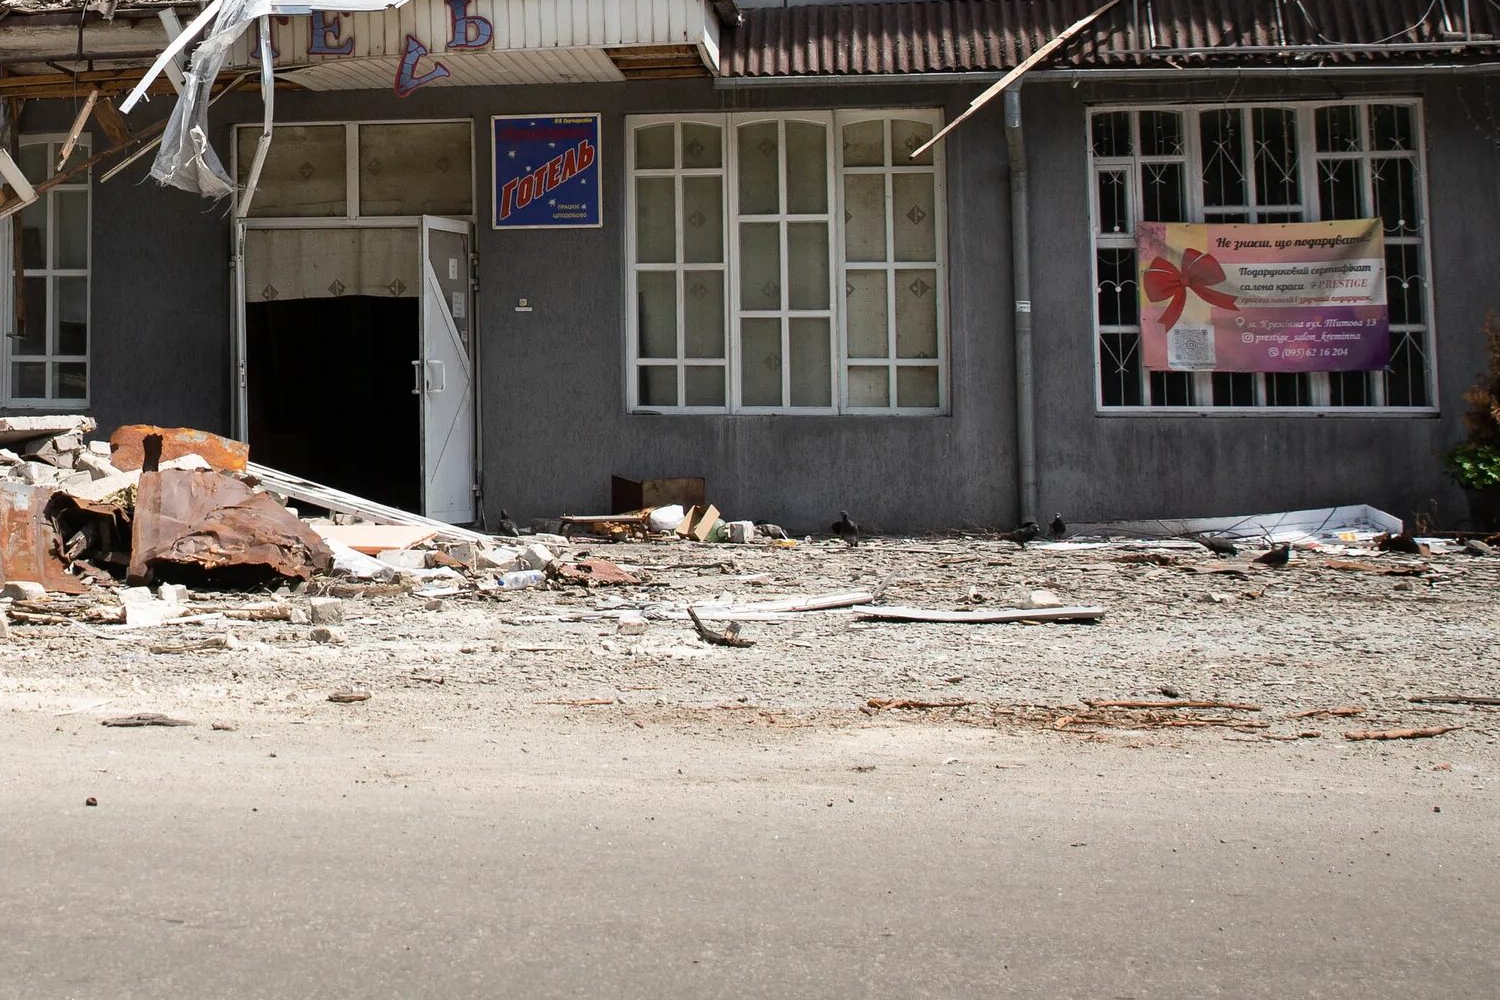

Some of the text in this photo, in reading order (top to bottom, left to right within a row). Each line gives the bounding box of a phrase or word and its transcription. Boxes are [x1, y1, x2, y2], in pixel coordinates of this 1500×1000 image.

[499, 139, 596, 221] ГОТЕЛЬ
[1216, 237, 1231, 248] Не
[1274, 239, 1291, 249] що
[1238, 263, 1371, 278] Подарунковий сертифікат
[1240, 278, 1368, 293] салона краси PRESTIGE
[1259, 320, 1304, 330] Кремінна
[1305, 321, 1322, 331] вул.
[1323, 318, 1363, 328] Титова
[1365, 317, 1376, 327] 13
[1255, 331, 1361, 344] prestige_salon_kreminna
[1281, 347, 1349, 359] (095) 62 16 204
